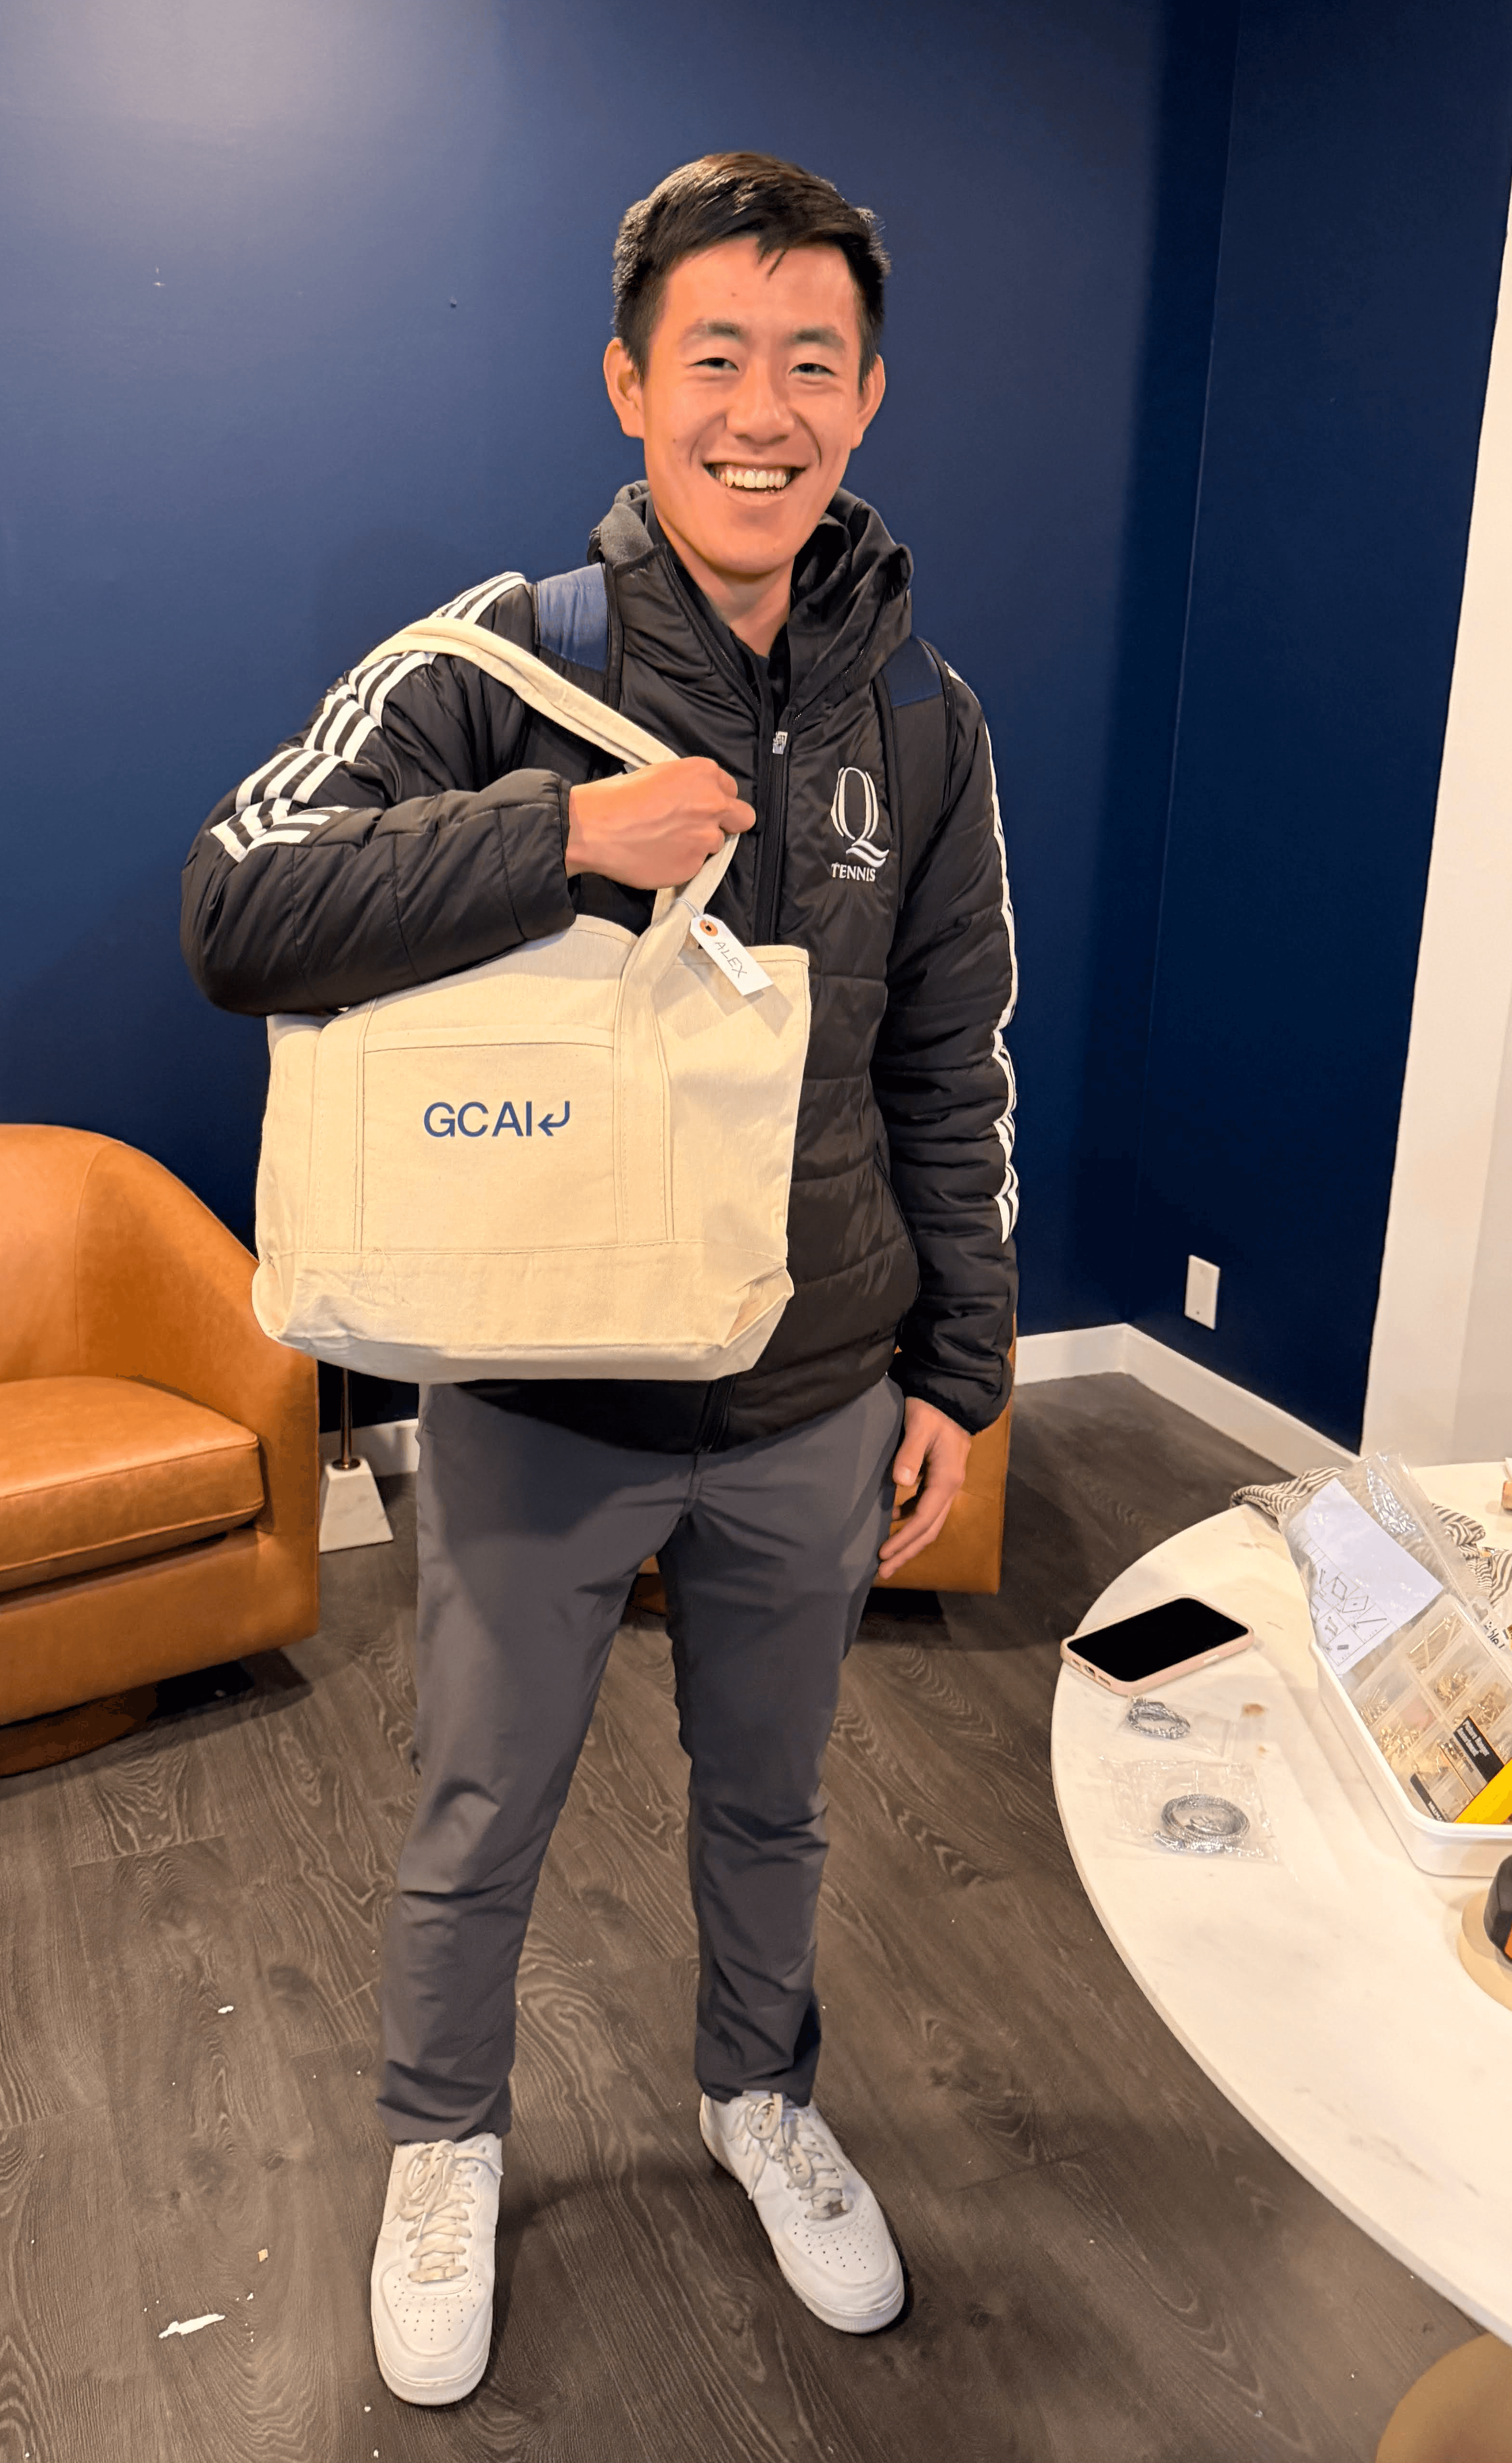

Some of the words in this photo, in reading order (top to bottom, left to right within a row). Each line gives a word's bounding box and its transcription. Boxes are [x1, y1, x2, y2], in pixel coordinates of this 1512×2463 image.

[831, 767, 889, 867] Q
[831, 863, 876, 882] TENNIS
[715, 941, 747, 978] ALEX
